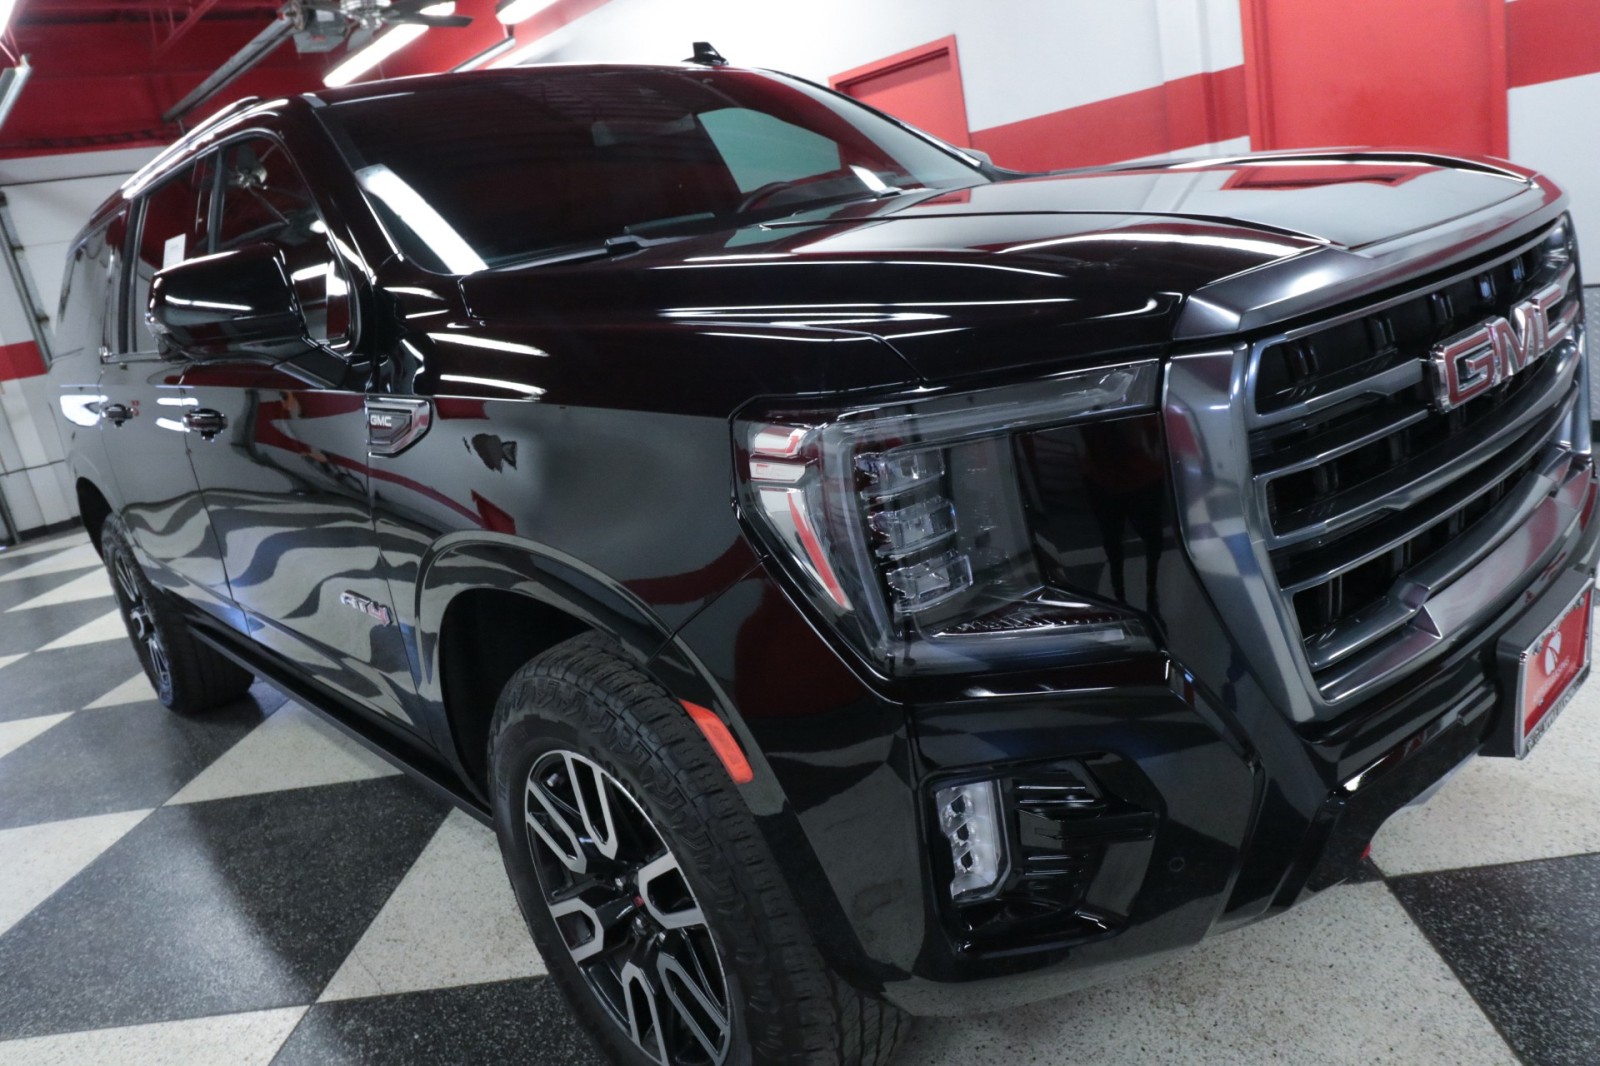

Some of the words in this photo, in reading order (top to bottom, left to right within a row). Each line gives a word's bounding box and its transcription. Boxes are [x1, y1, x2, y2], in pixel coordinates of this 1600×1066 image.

[1440, 284, 1568, 410] GMC
[370, 414, 392, 427] GMC
[340, 590, 391, 627] AT4
